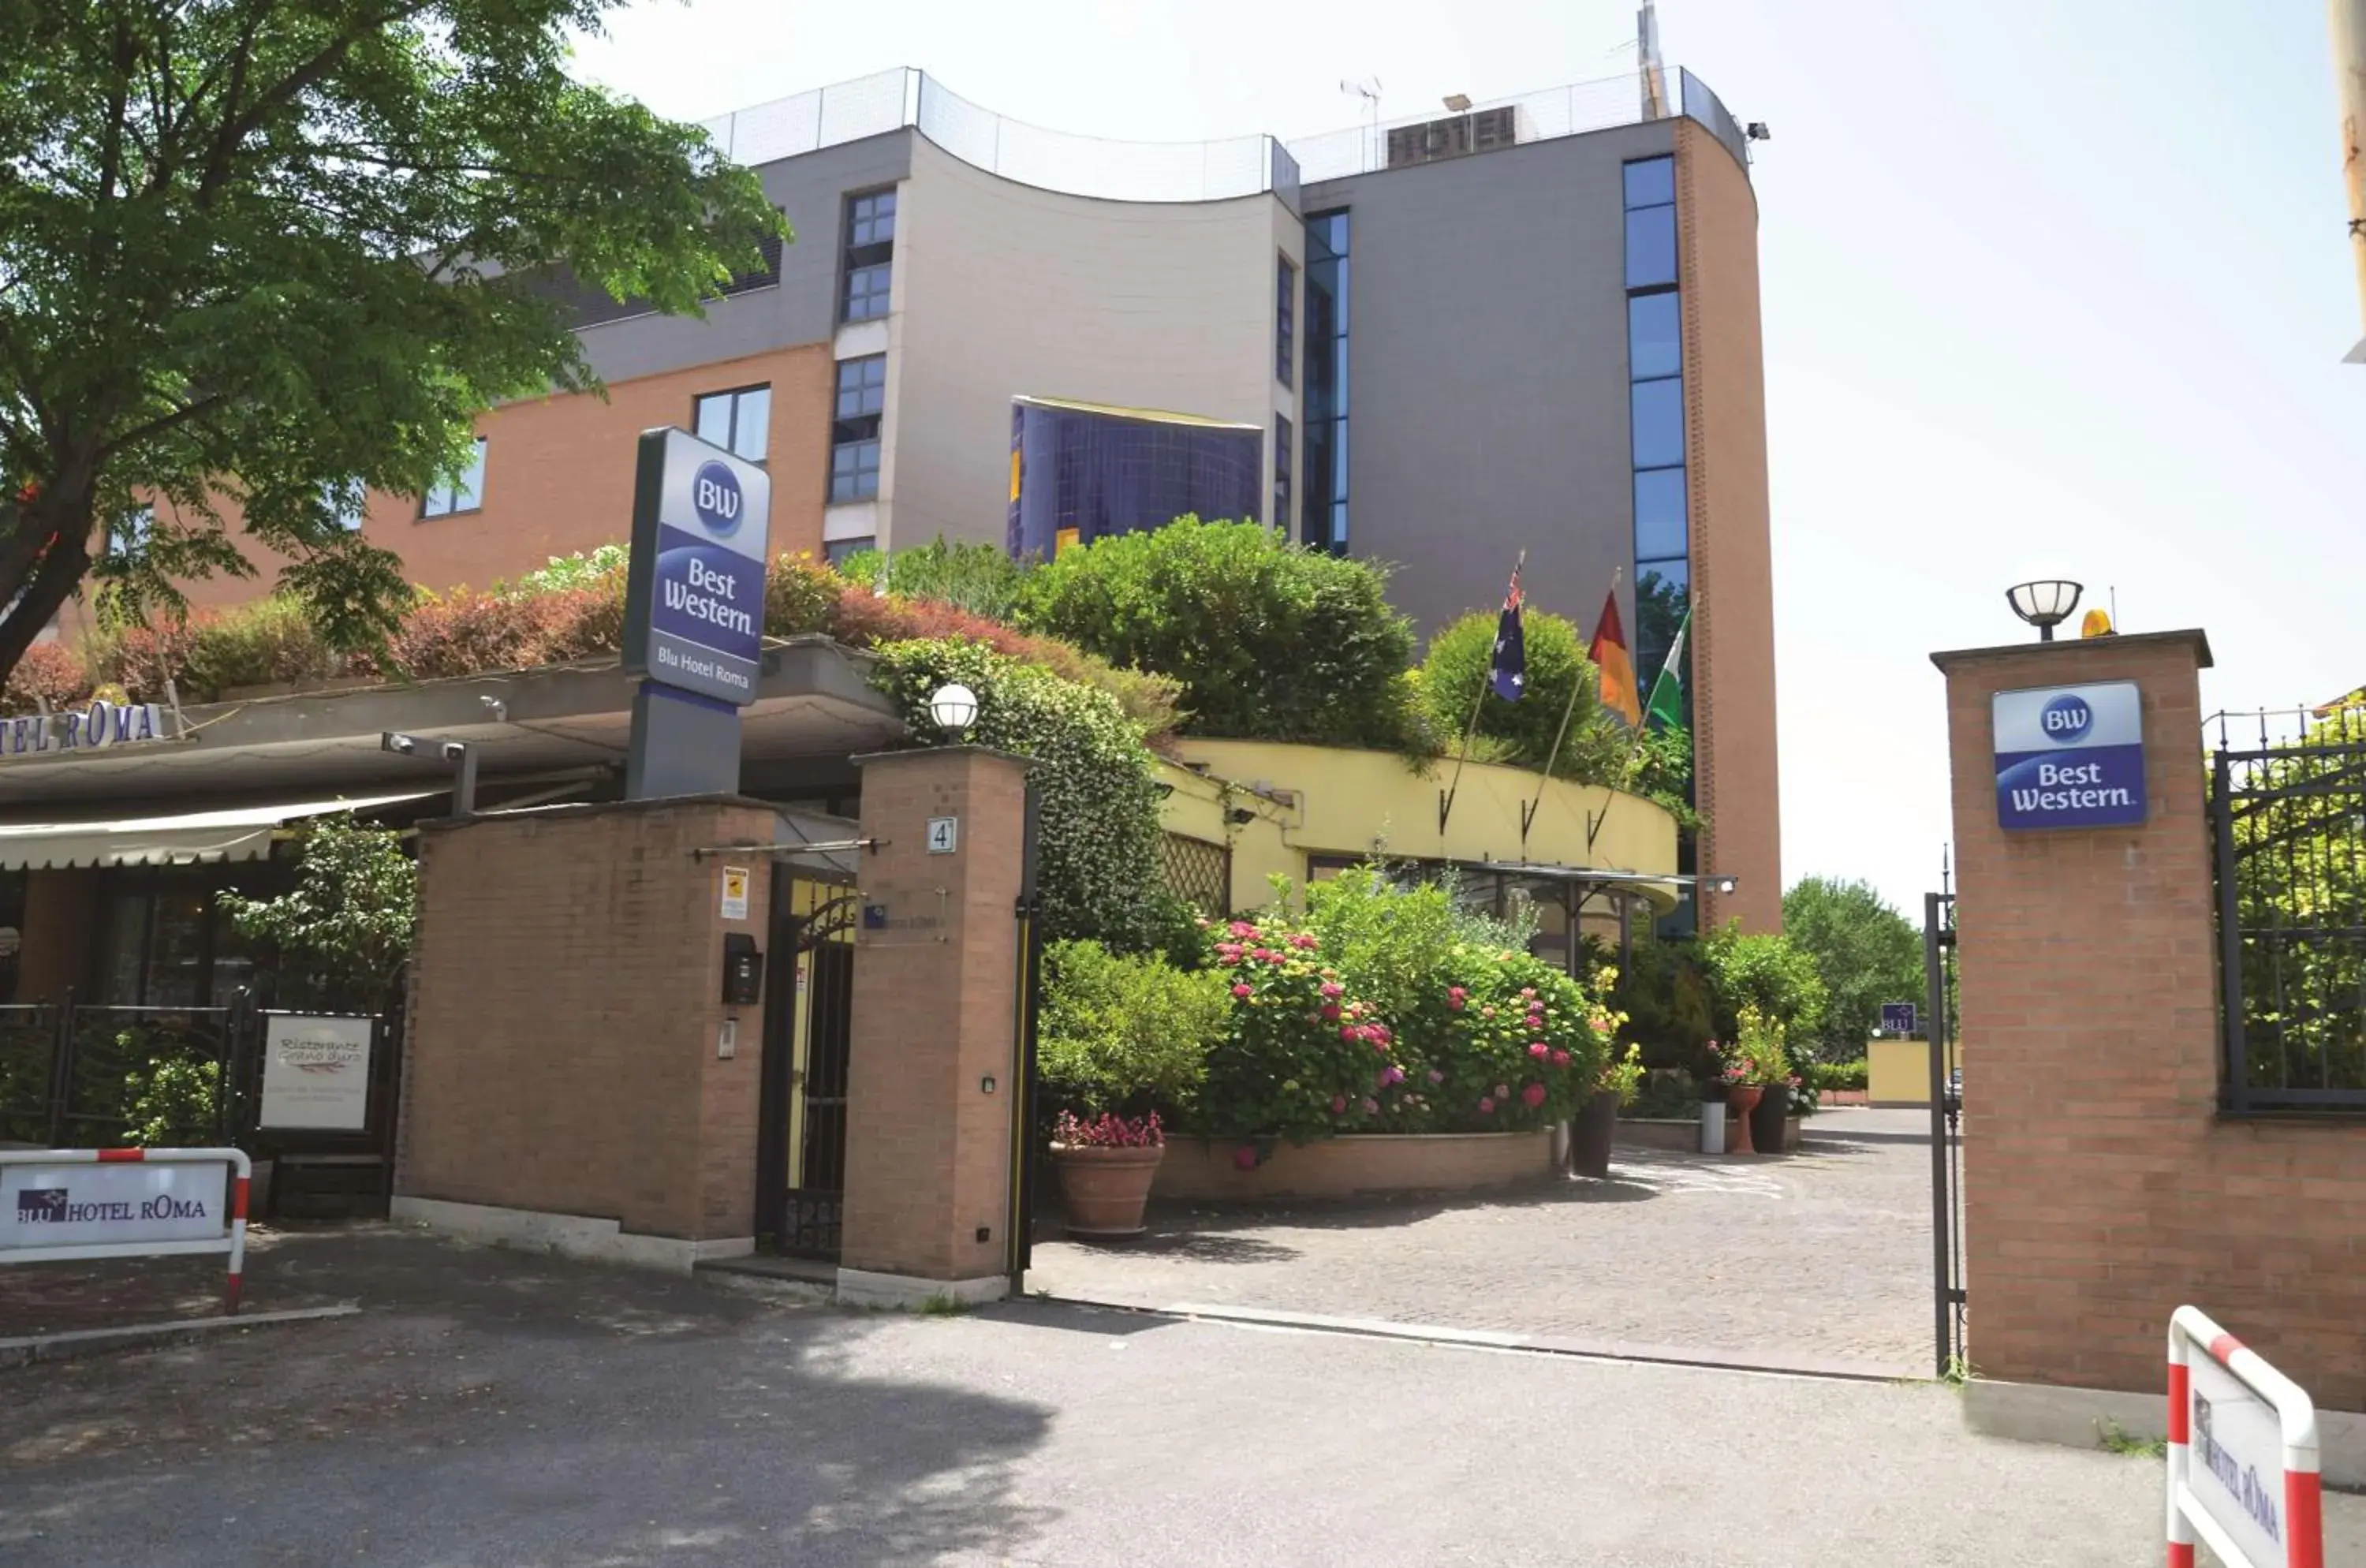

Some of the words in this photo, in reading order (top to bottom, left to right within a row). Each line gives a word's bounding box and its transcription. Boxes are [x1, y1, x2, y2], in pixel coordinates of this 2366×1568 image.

[698, 478, 738, 518] BW
[689, 558, 736, 600] Best
[666, 578, 752, 634] Western
[659, 647, 678, 666] Blu
[681, 653, 713, 677] Hotel
[716, 666, 748, 688] Roma
[62, 701, 154, 749] ROMA
[2047, 708, 2087, 730] BW
[2039, 763, 2101, 786] Best
[2012, 788, 2130, 812] Western
[934, 824, 947, 846] 4
[1883, 1019, 1909, 1030] BLU
[69, 1202, 134, 1222] HOTEL
[141, 1194, 207, 1219] ROMA
